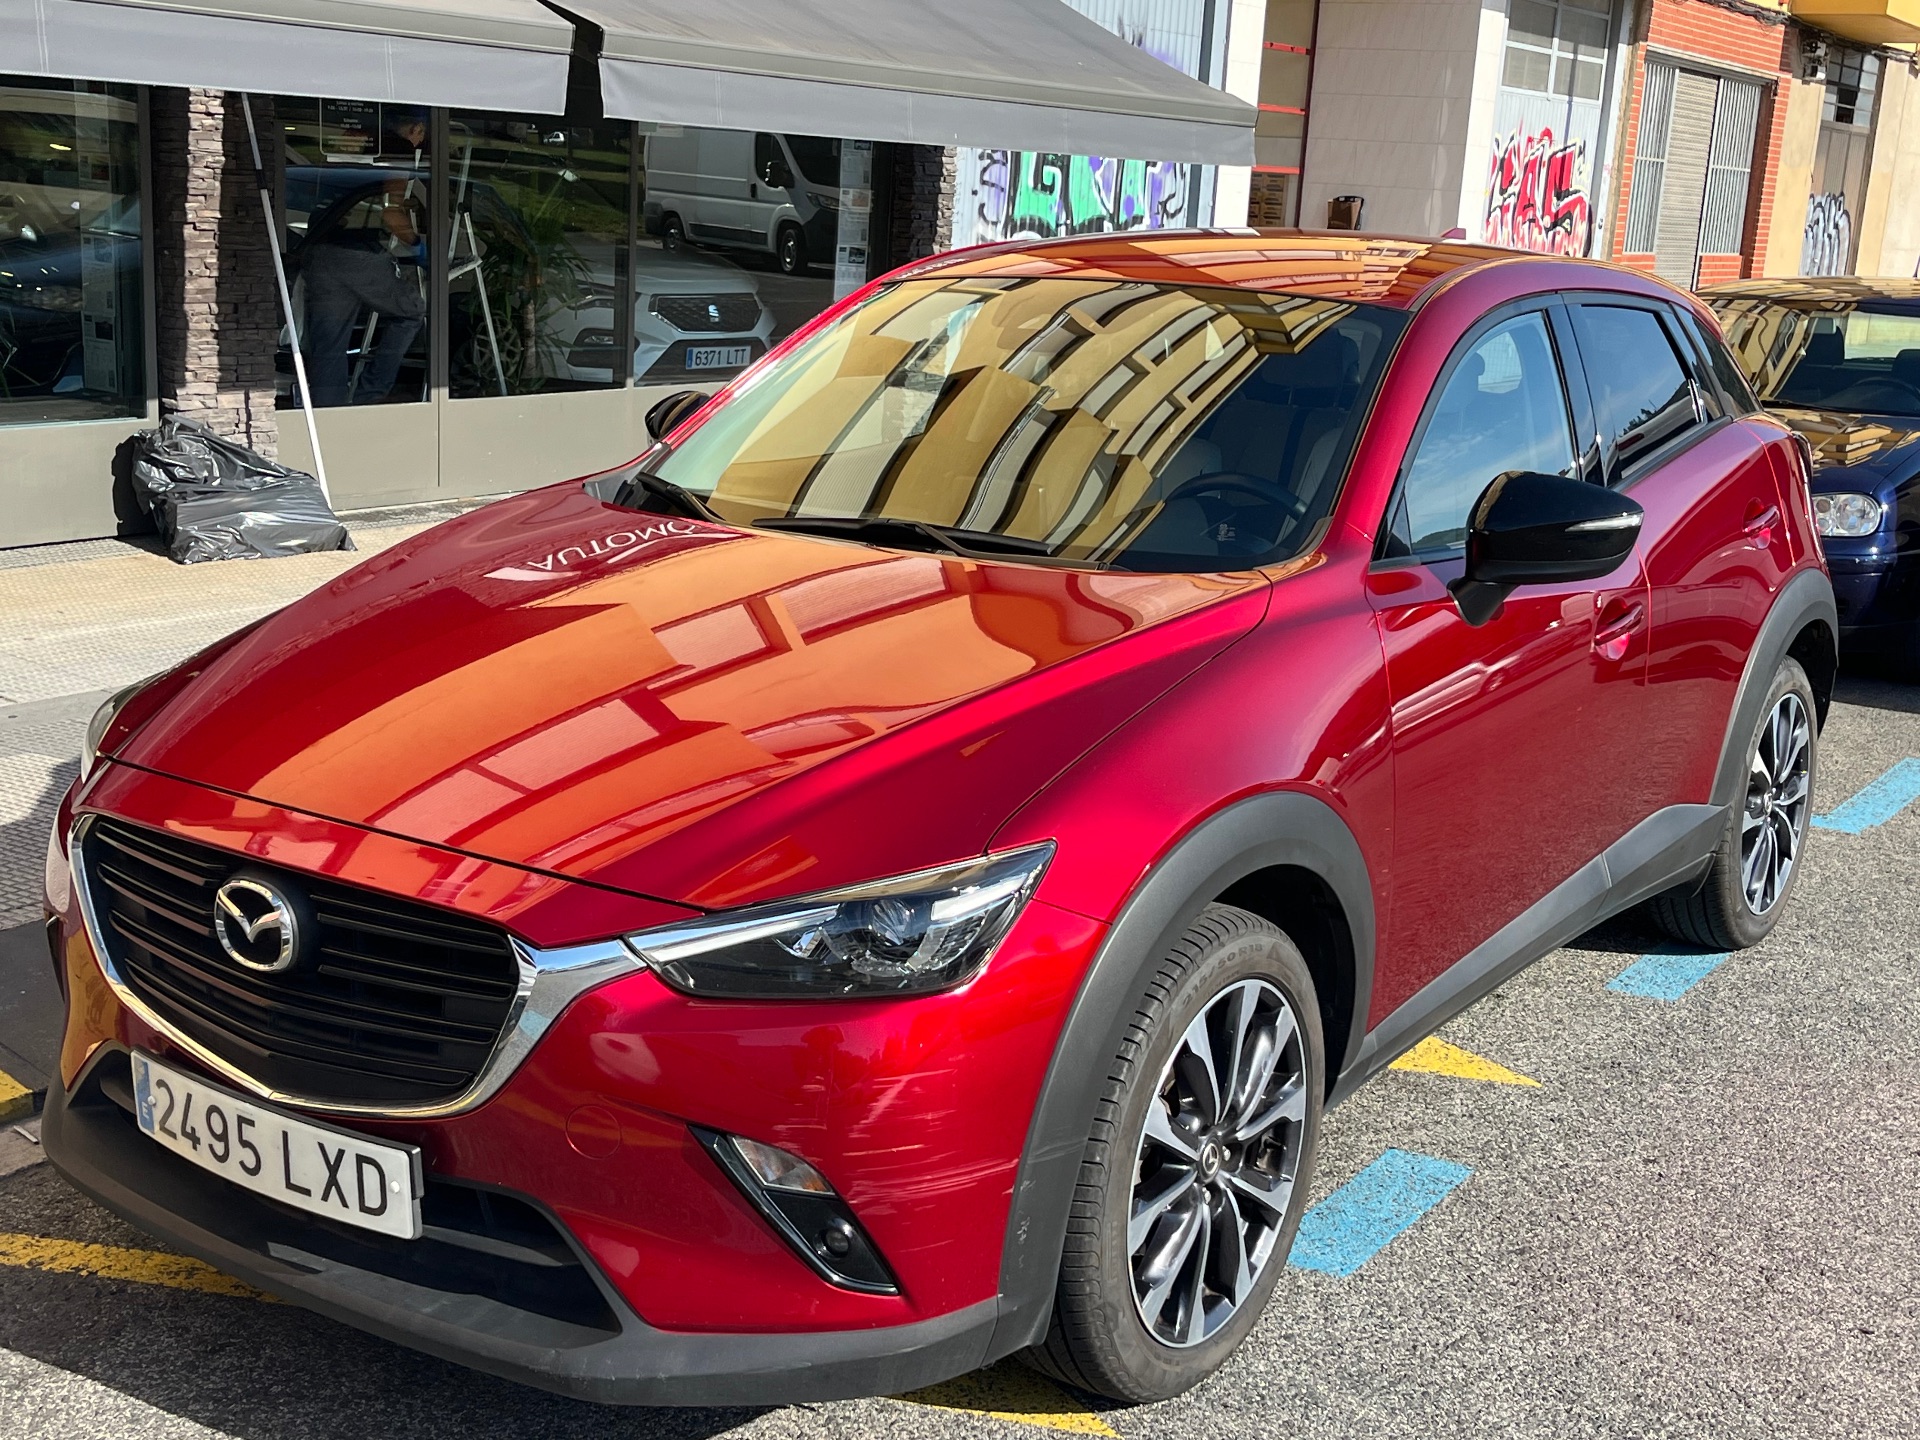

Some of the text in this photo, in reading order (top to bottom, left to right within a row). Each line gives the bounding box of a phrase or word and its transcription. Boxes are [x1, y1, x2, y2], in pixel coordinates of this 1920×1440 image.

[695, 350, 722, 366] 6371
[726, 348, 747, 365] LTT
[156, 1079, 261, 1177] 2495
[282, 1130, 387, 1216] LXD
